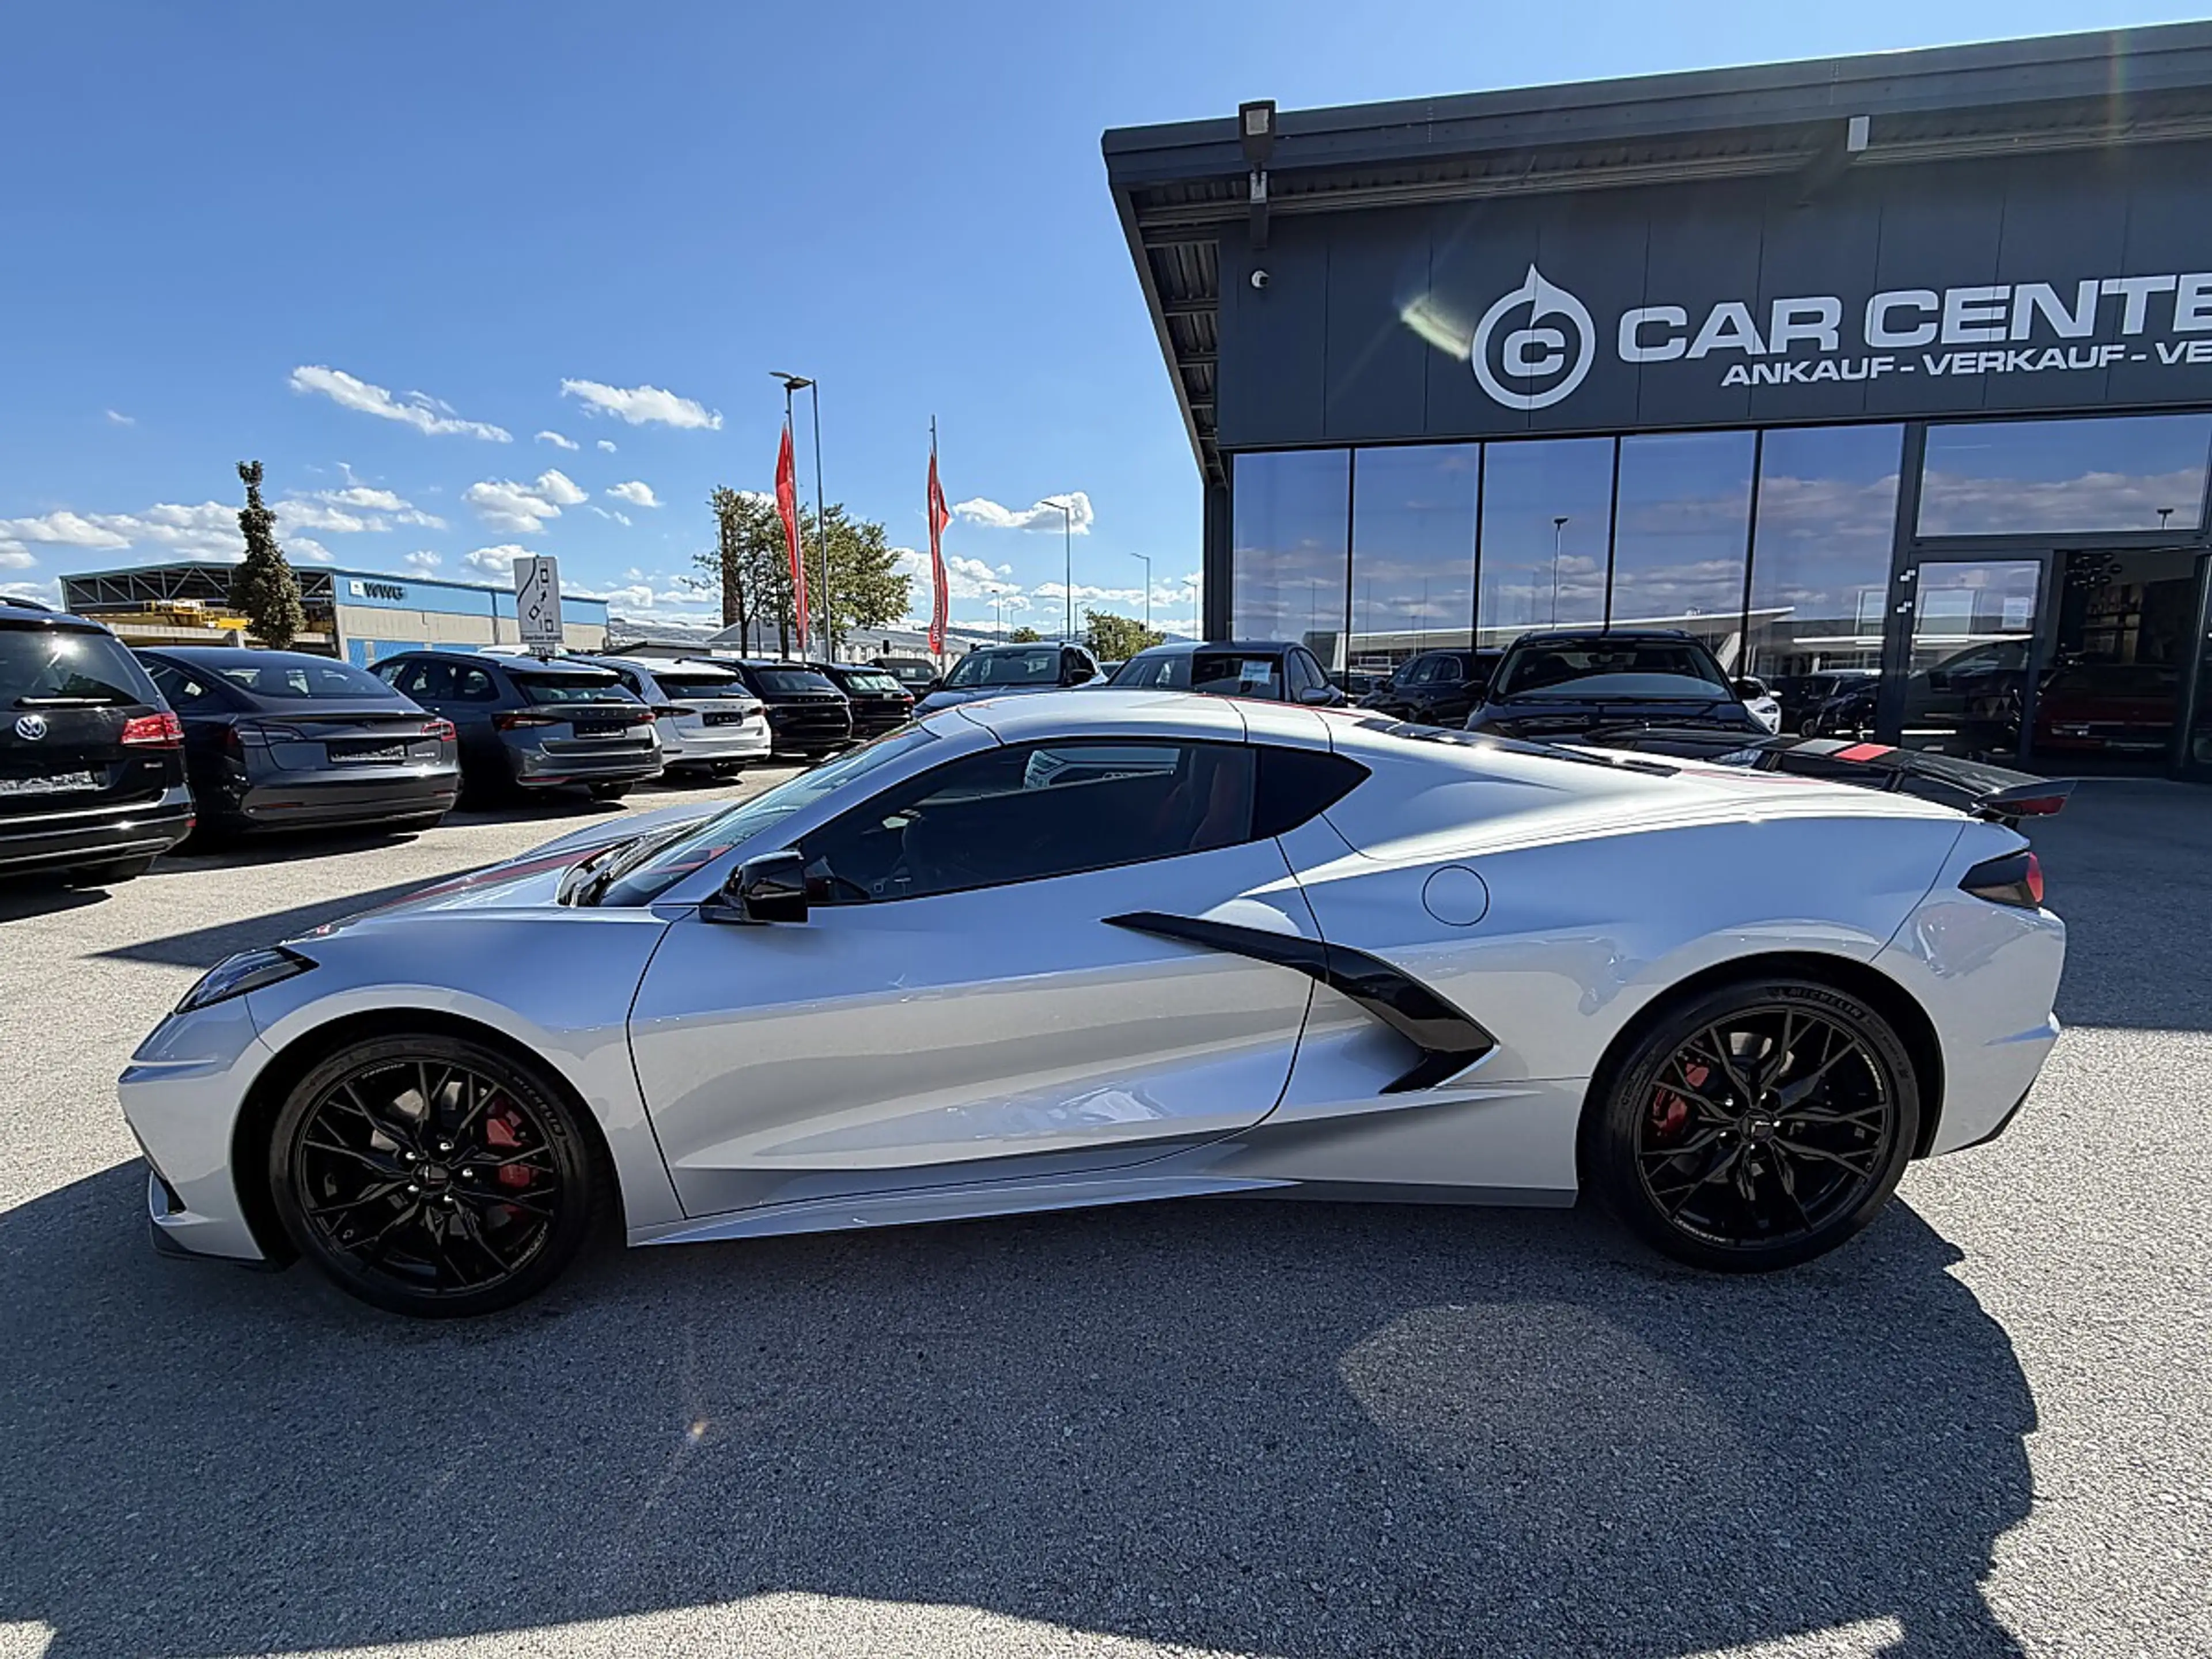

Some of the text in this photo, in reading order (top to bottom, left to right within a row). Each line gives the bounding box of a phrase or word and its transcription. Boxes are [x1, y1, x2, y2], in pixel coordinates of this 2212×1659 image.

[1618, 272, 2212, 362] CAR CENTE
[1721, 355, 1895, 387] ANKAUF
[1922, 344, 2126, 376] VERKAUF
